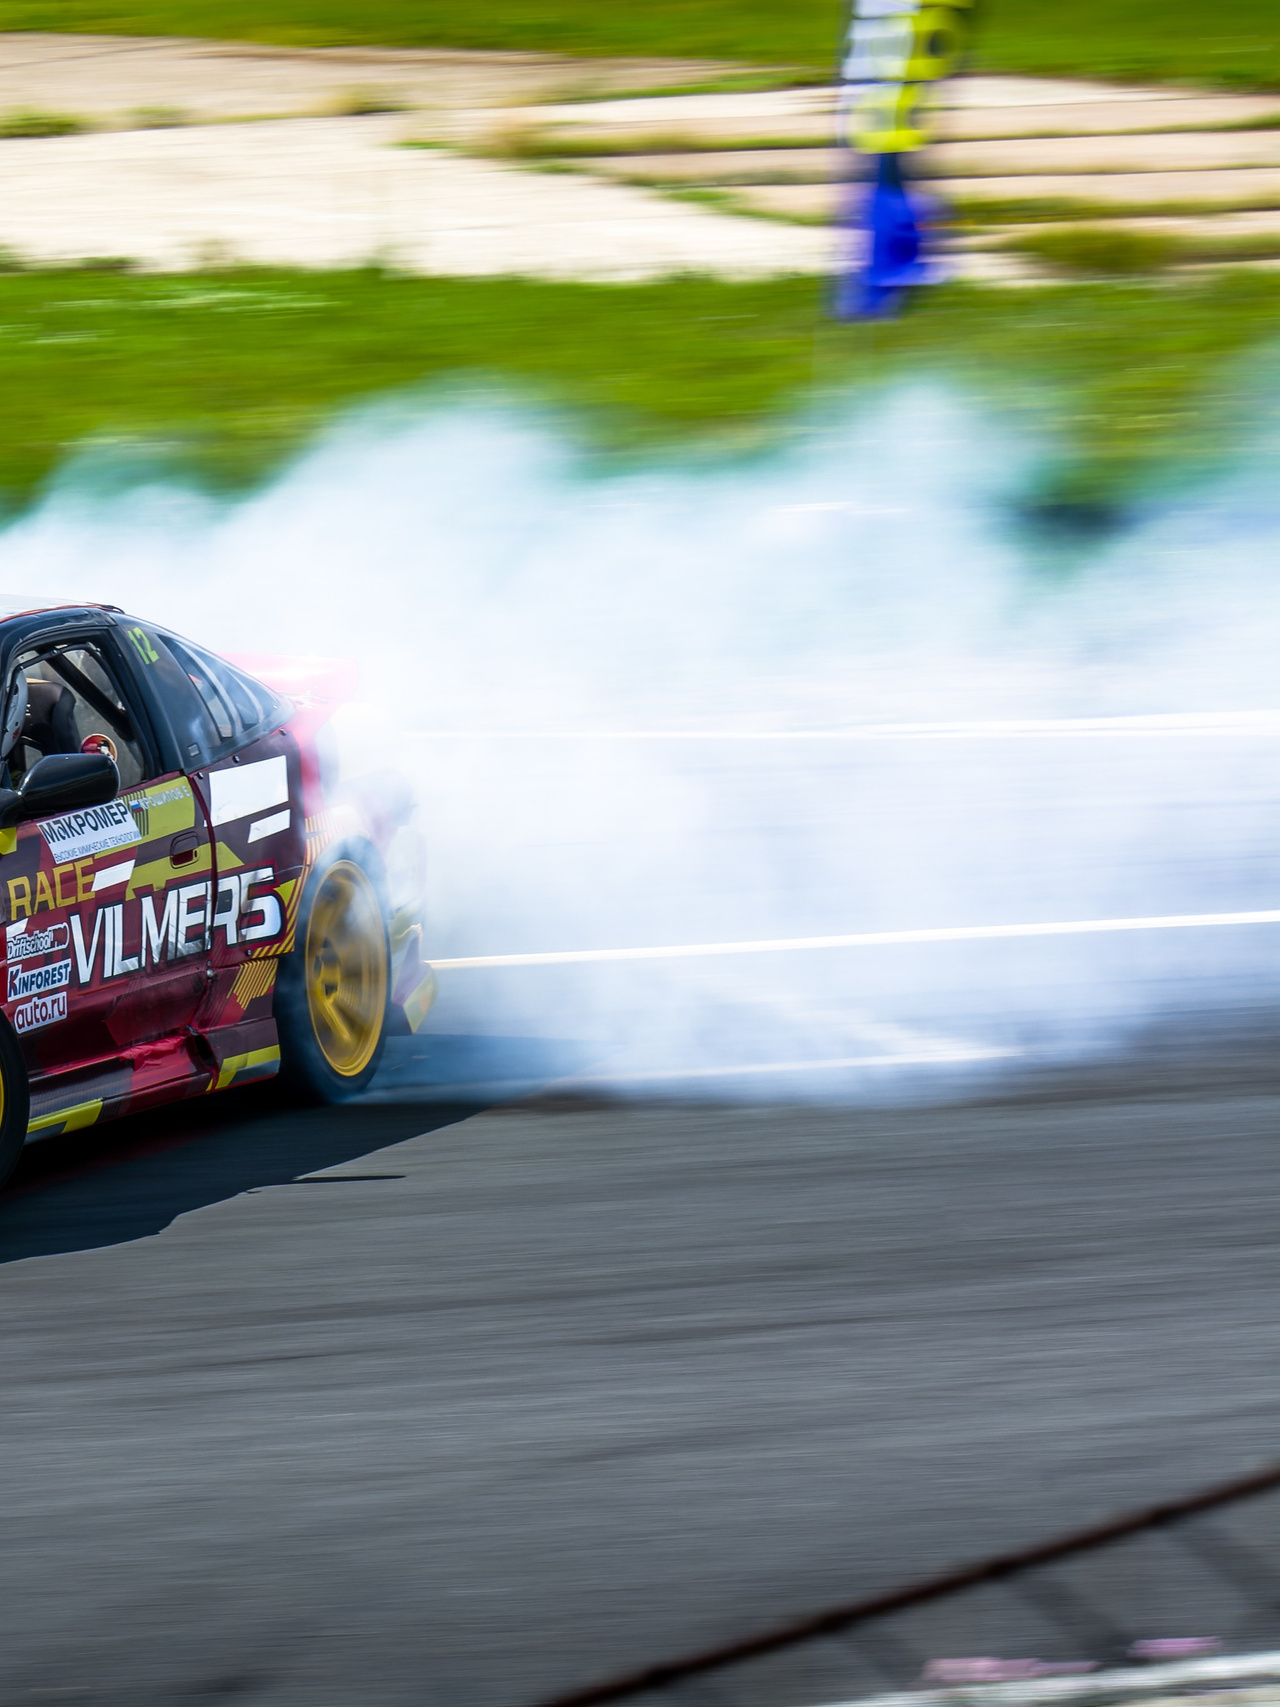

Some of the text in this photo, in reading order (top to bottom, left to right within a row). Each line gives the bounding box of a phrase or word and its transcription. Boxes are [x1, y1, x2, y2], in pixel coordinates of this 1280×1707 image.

[127, 627, 160, 665] 12
[7, 857, 96, 921] RACE
[69, 867, 282, 984] VILMERS
[8, 963, 70, 998] KINFOREST
[16, 995, 66, 1030] auto.ru
